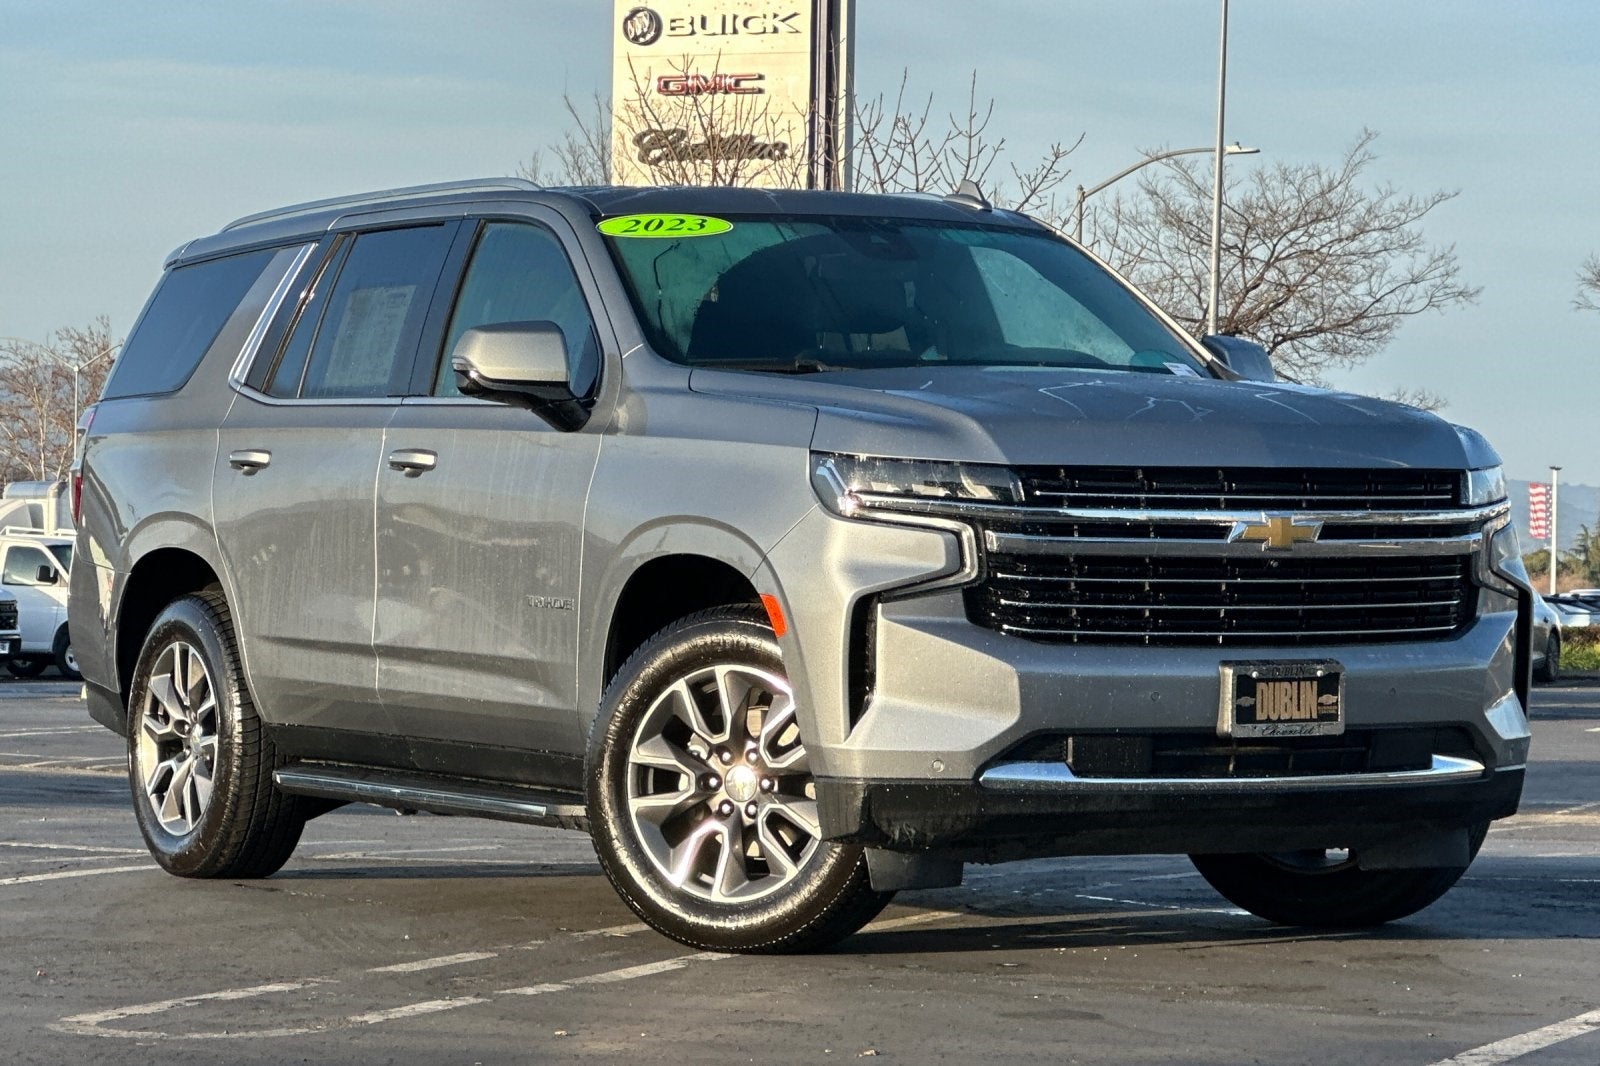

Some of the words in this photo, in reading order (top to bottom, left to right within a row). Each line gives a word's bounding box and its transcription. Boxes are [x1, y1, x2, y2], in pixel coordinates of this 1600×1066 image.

[666, 12, 802, 37] BUICK
[657, 73, 766, 96] GMC
[620, 218, 708, 233] 2023
[1256, 681, 1318, 721] DUBLIN
